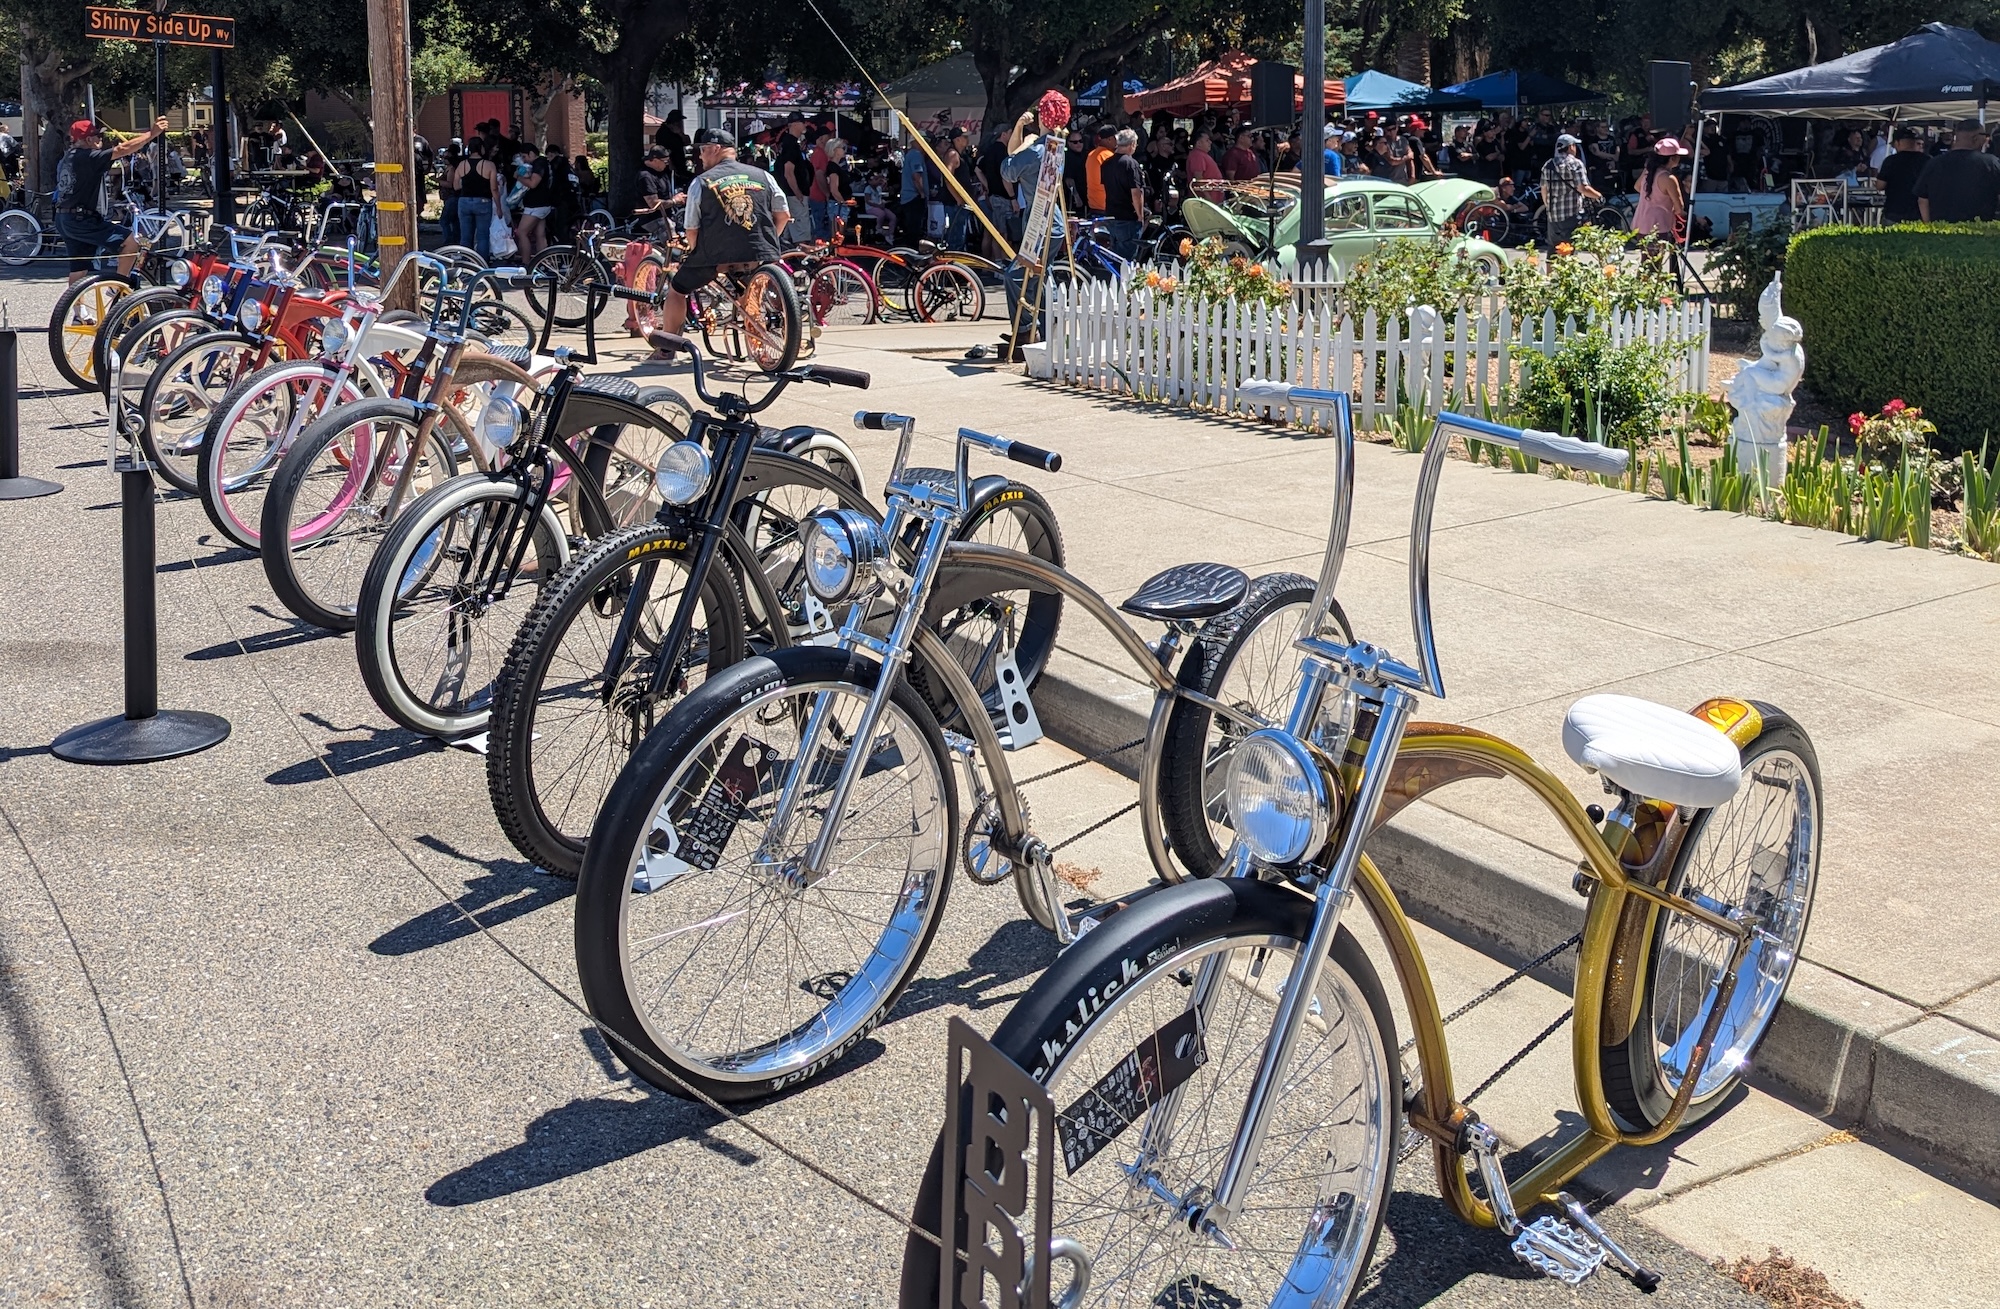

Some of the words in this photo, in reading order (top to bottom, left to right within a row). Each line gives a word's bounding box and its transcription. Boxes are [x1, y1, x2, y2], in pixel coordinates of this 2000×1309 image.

[90, 10, 141, 37] Shiny
[146, 15, 184, 35] Side
[188, 18, 211, 41] Up
[216, 28, 230, 41] Wy
[983, 491, 1024, 512] MAXXIS
[627, 540, 687, 560] MAXXIS
[1031, 957, 1144, 1083] ckslick
[771, 1005, 887, 1091] thickslick
